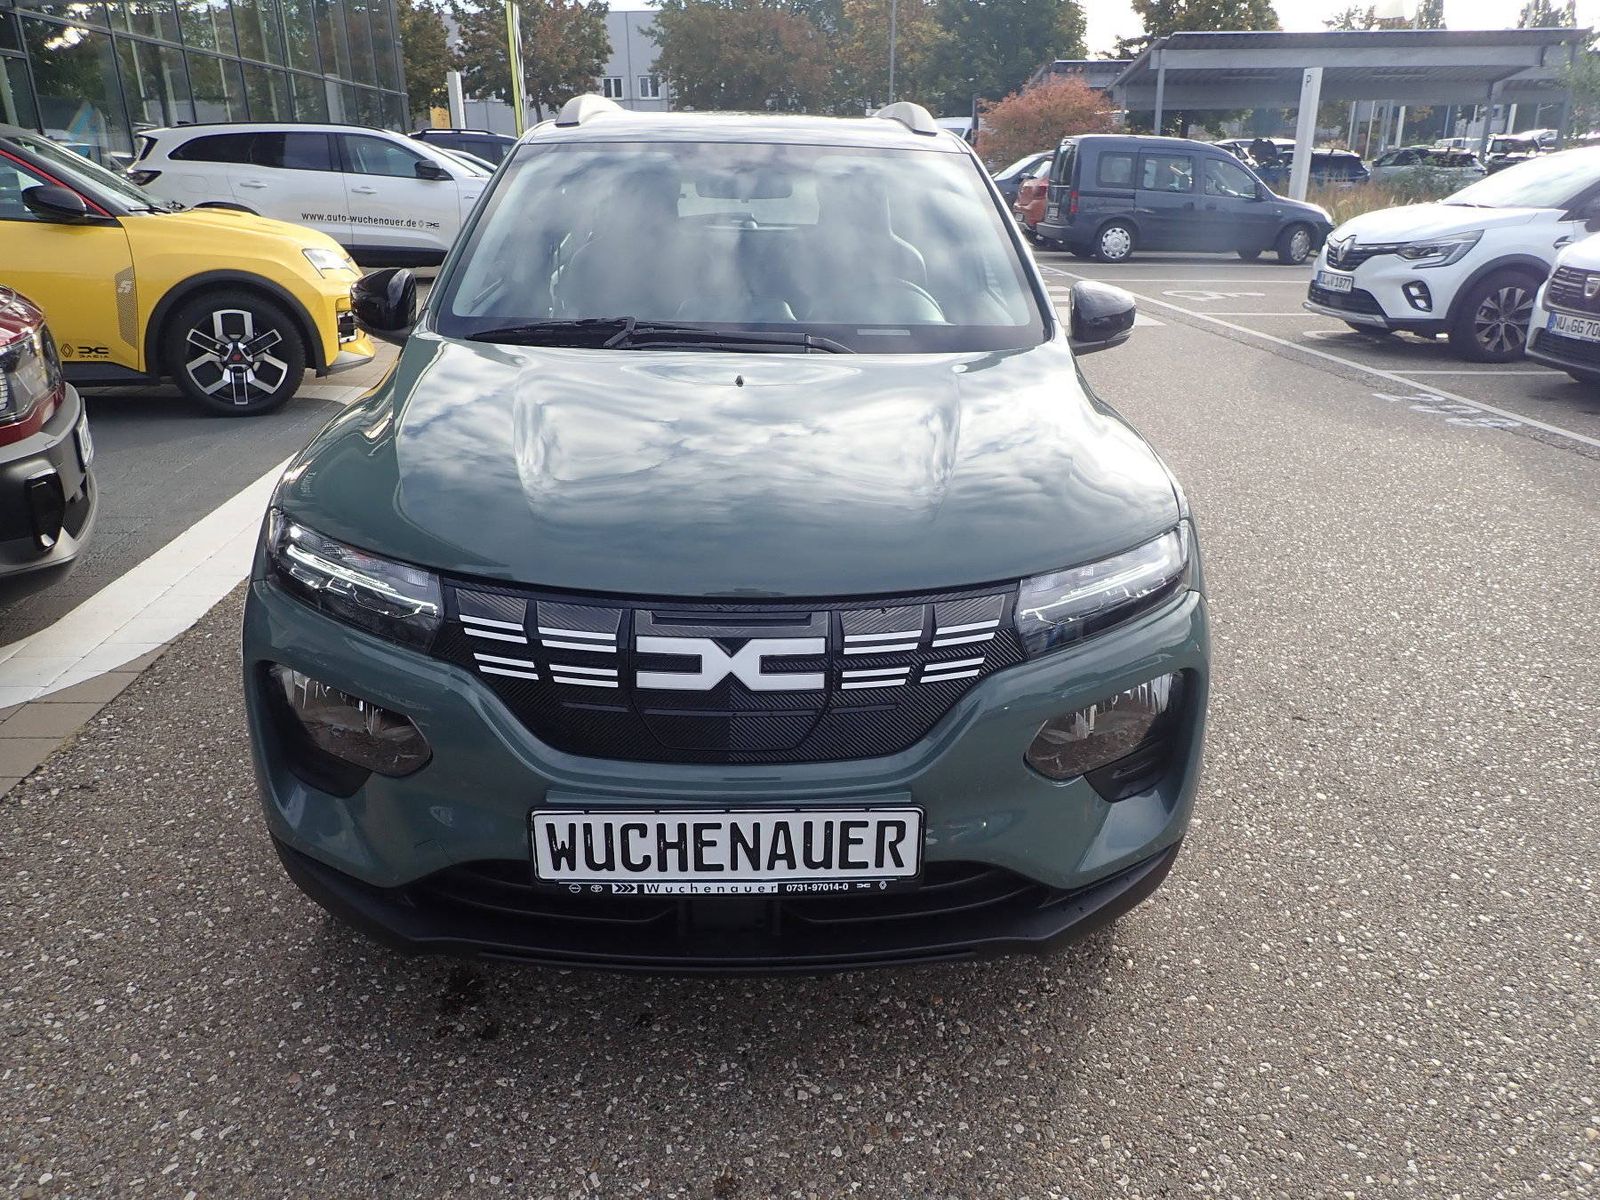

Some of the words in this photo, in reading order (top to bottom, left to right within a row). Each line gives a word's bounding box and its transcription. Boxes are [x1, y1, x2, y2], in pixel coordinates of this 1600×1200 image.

[301, 212, 417, 227] www.auto-wuchenauer.de
[1586, 321, 1600, 337] 70
[546, 820, 906, 873] WUCHENAUER
[647, 883, 777, 893] Wuchenauer
[786, 883, 849, 892] 0731-97014-0
